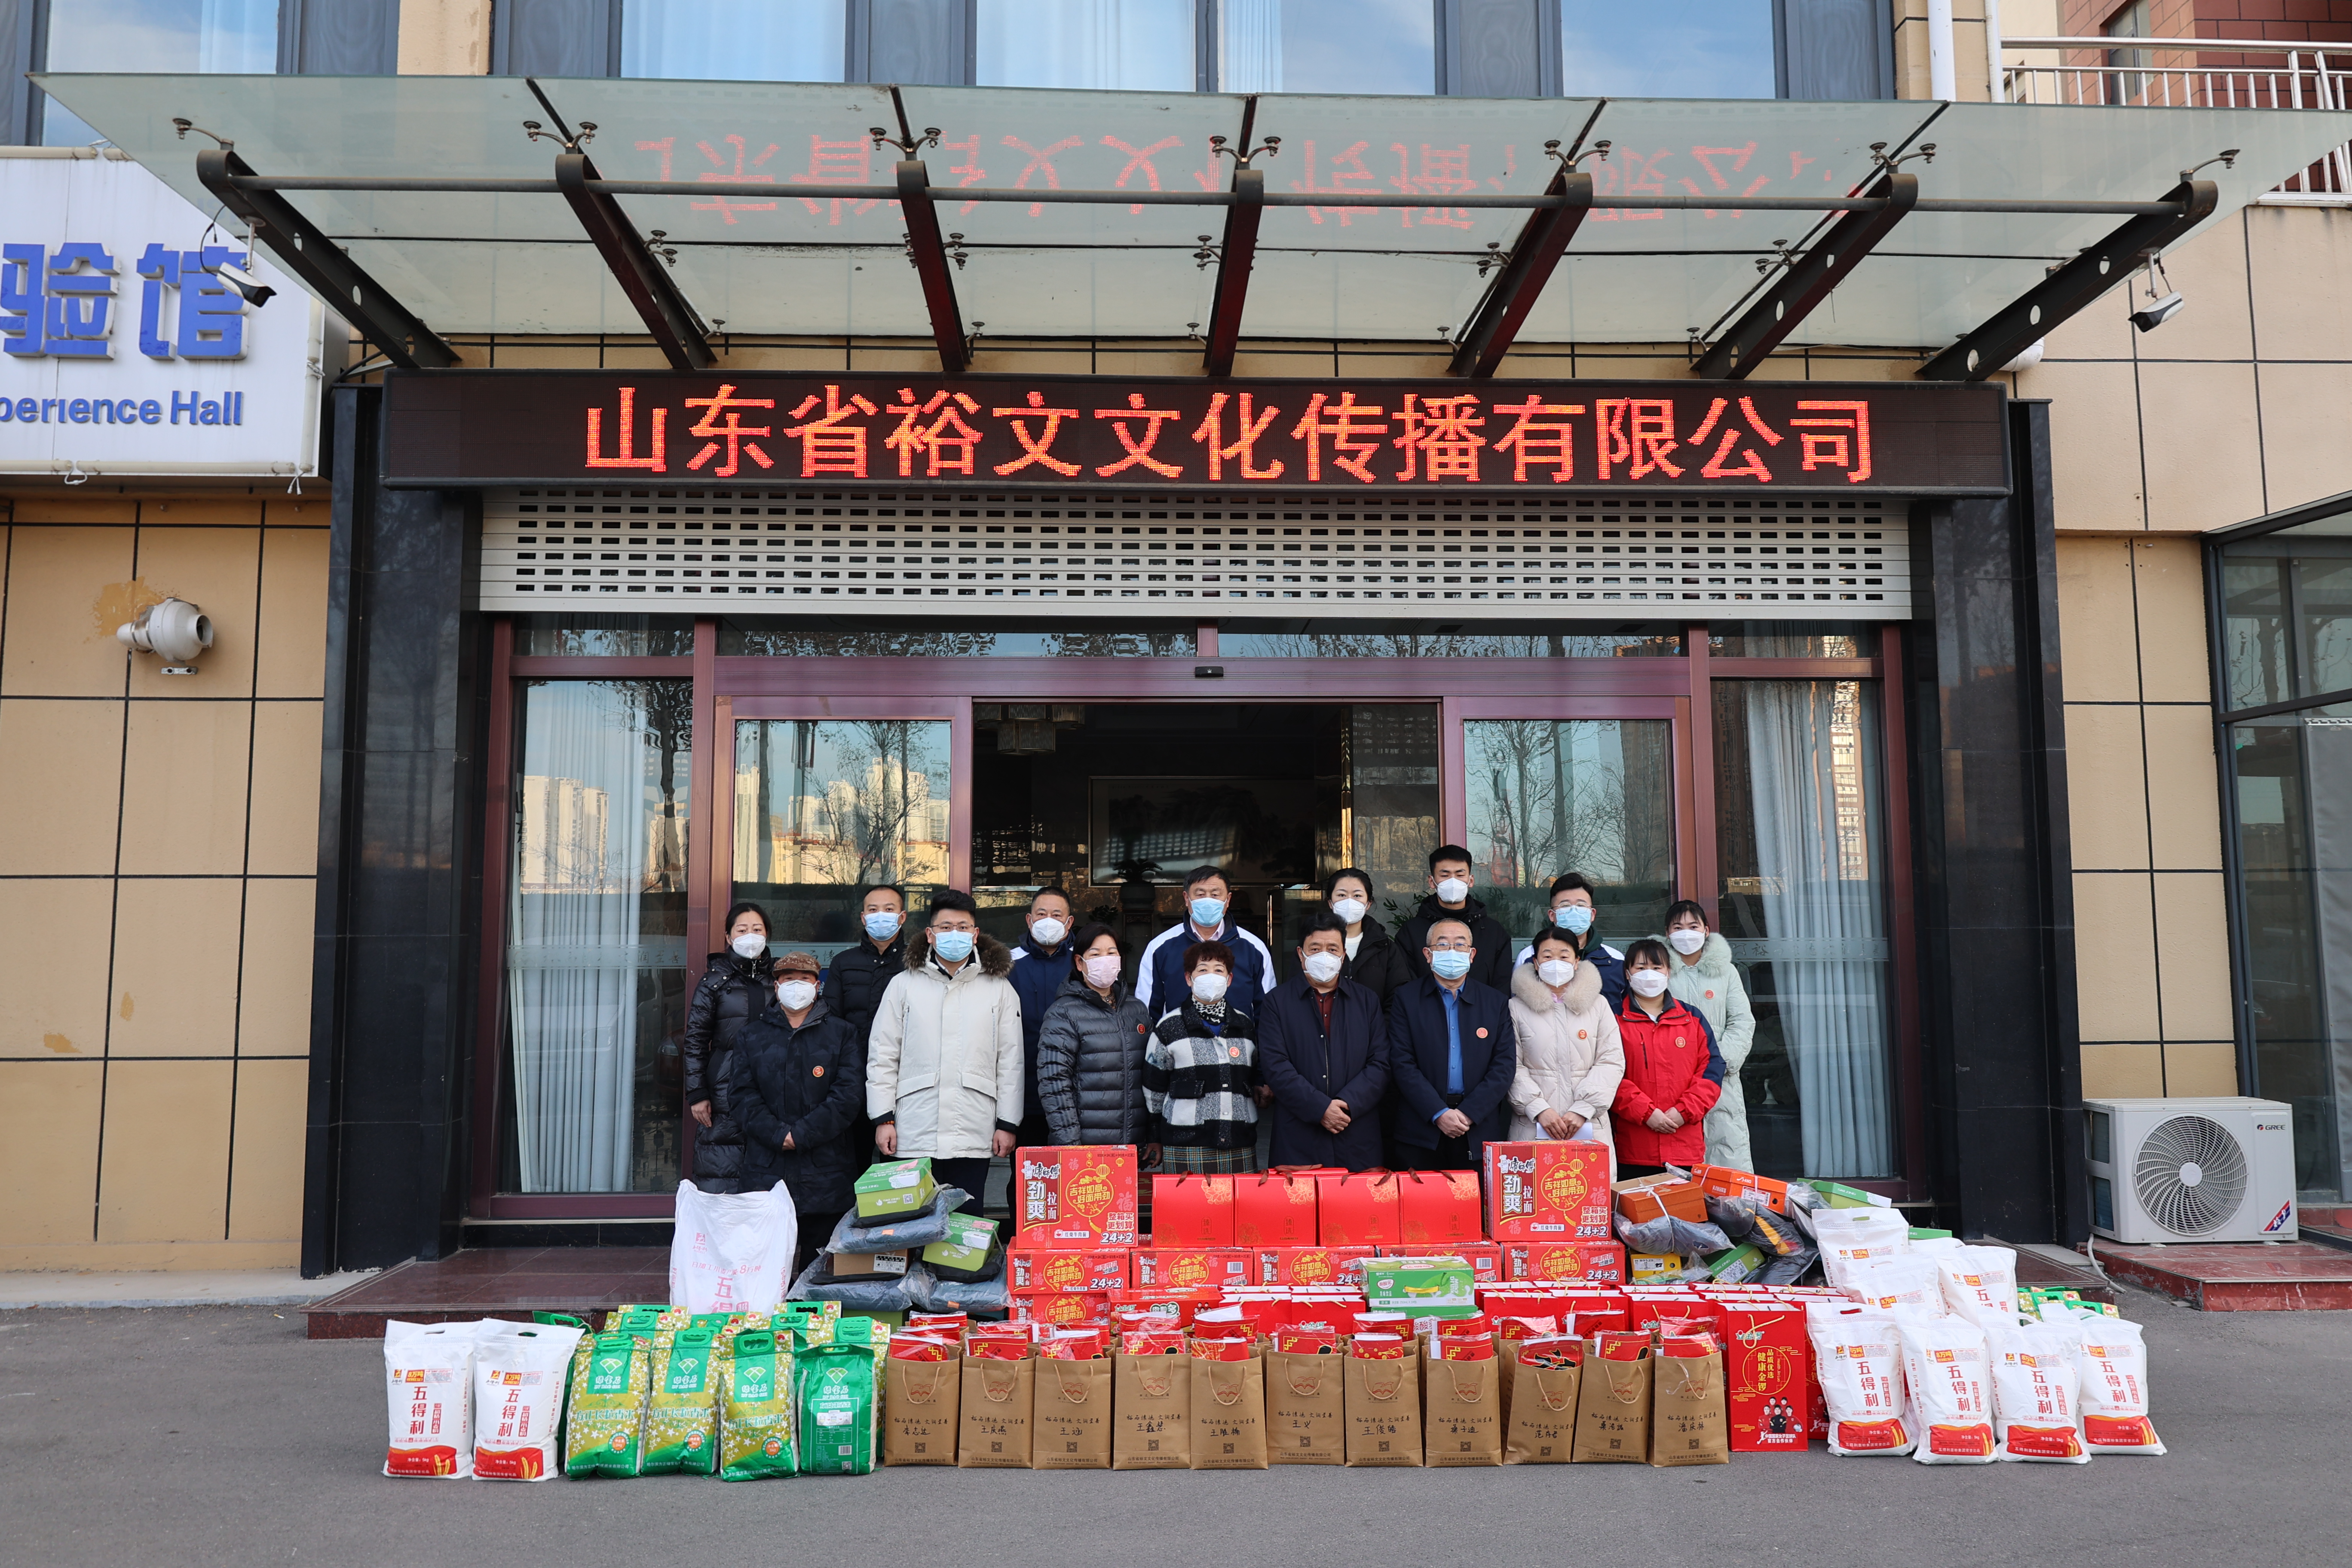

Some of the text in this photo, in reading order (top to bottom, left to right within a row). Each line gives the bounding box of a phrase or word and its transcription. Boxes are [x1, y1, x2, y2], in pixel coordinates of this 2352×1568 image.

[0, 243, 250, 358] 验馆
[171, 390, 243, 425] Hall
[585, 383, 1872, 483] 山东省裕文文化传播有限公司
[1069, 1184, 1108, 1196] 吉祥如意
[1545, 1179, 1581, 1190] 吉祥如意
[1504, 1174, 1522, 1213] 劲爽
[1548, 1186, 1584, 1197] 好面带劲
[1027, 1181, 1046, 1220] 劲爽
[1073, 1192, 1111, 1204] 好面带劲
[1523, 1185, 1533, 1213] 拉面
[1047, 1191, 1057, 1220] 拉面
[1582, 1206, 1608, 1214] 整箱买
[1108, 1212, 1134, 1221] 整箱买
[1581, 1215, 1608, 1223] 更划算
[1107, 1221, 1134, 1231] 更划算
[1575, 1225, 1608, 1237] 24+2
[1100, 1232, 1134, 1243] 24+2
[1294, 1262, 1326, 1272] 吉祥如意
[1513, 1258, 1522, 1276] 劲爽
[1544, 1257, 1575, 1267] 吉祥如意
[1047, 1266, 1078, 1277] 吉祥如意
[1141, 1265, 1150, 1284] 劲爽
[1172, 1265, 1204, 1275] 吉祥如意
[1263, 1263, 1272, 1282] 劲爽
[1296, 1268, 1328, 1278] 好面带劲
[1547, 1263, 1577, 1274] 好面带劲
[1015, 1268, 1025, 1286] 劲爽
[1050, 1272, 1081, 1283] 好面带劲
[1175, 1271, 1206, 1281] 好面带劲
[1586, 1269, 1619, 1281] 24+2
[1090, 1277, 1124, 1290] 24+2
[1049, 1305, 1080, 1316] 吉祥如意
[1758, 1352, 1767, 1391] 健康金锣
[1856, 1361, 1879, 1407] 五得利
[2099, 1361, 2127, 1403] 五得利
[1946, 1365, 1970, 1412] 五得利
[2030, 1370, 2053, 1414] 五得利
[410, 1386, 428, 1435] 五得利
[498, 1389, 521, 1437] 五得利
[1588, 1451, 1639, 1460] 山东省裕文文化传播有限公司
